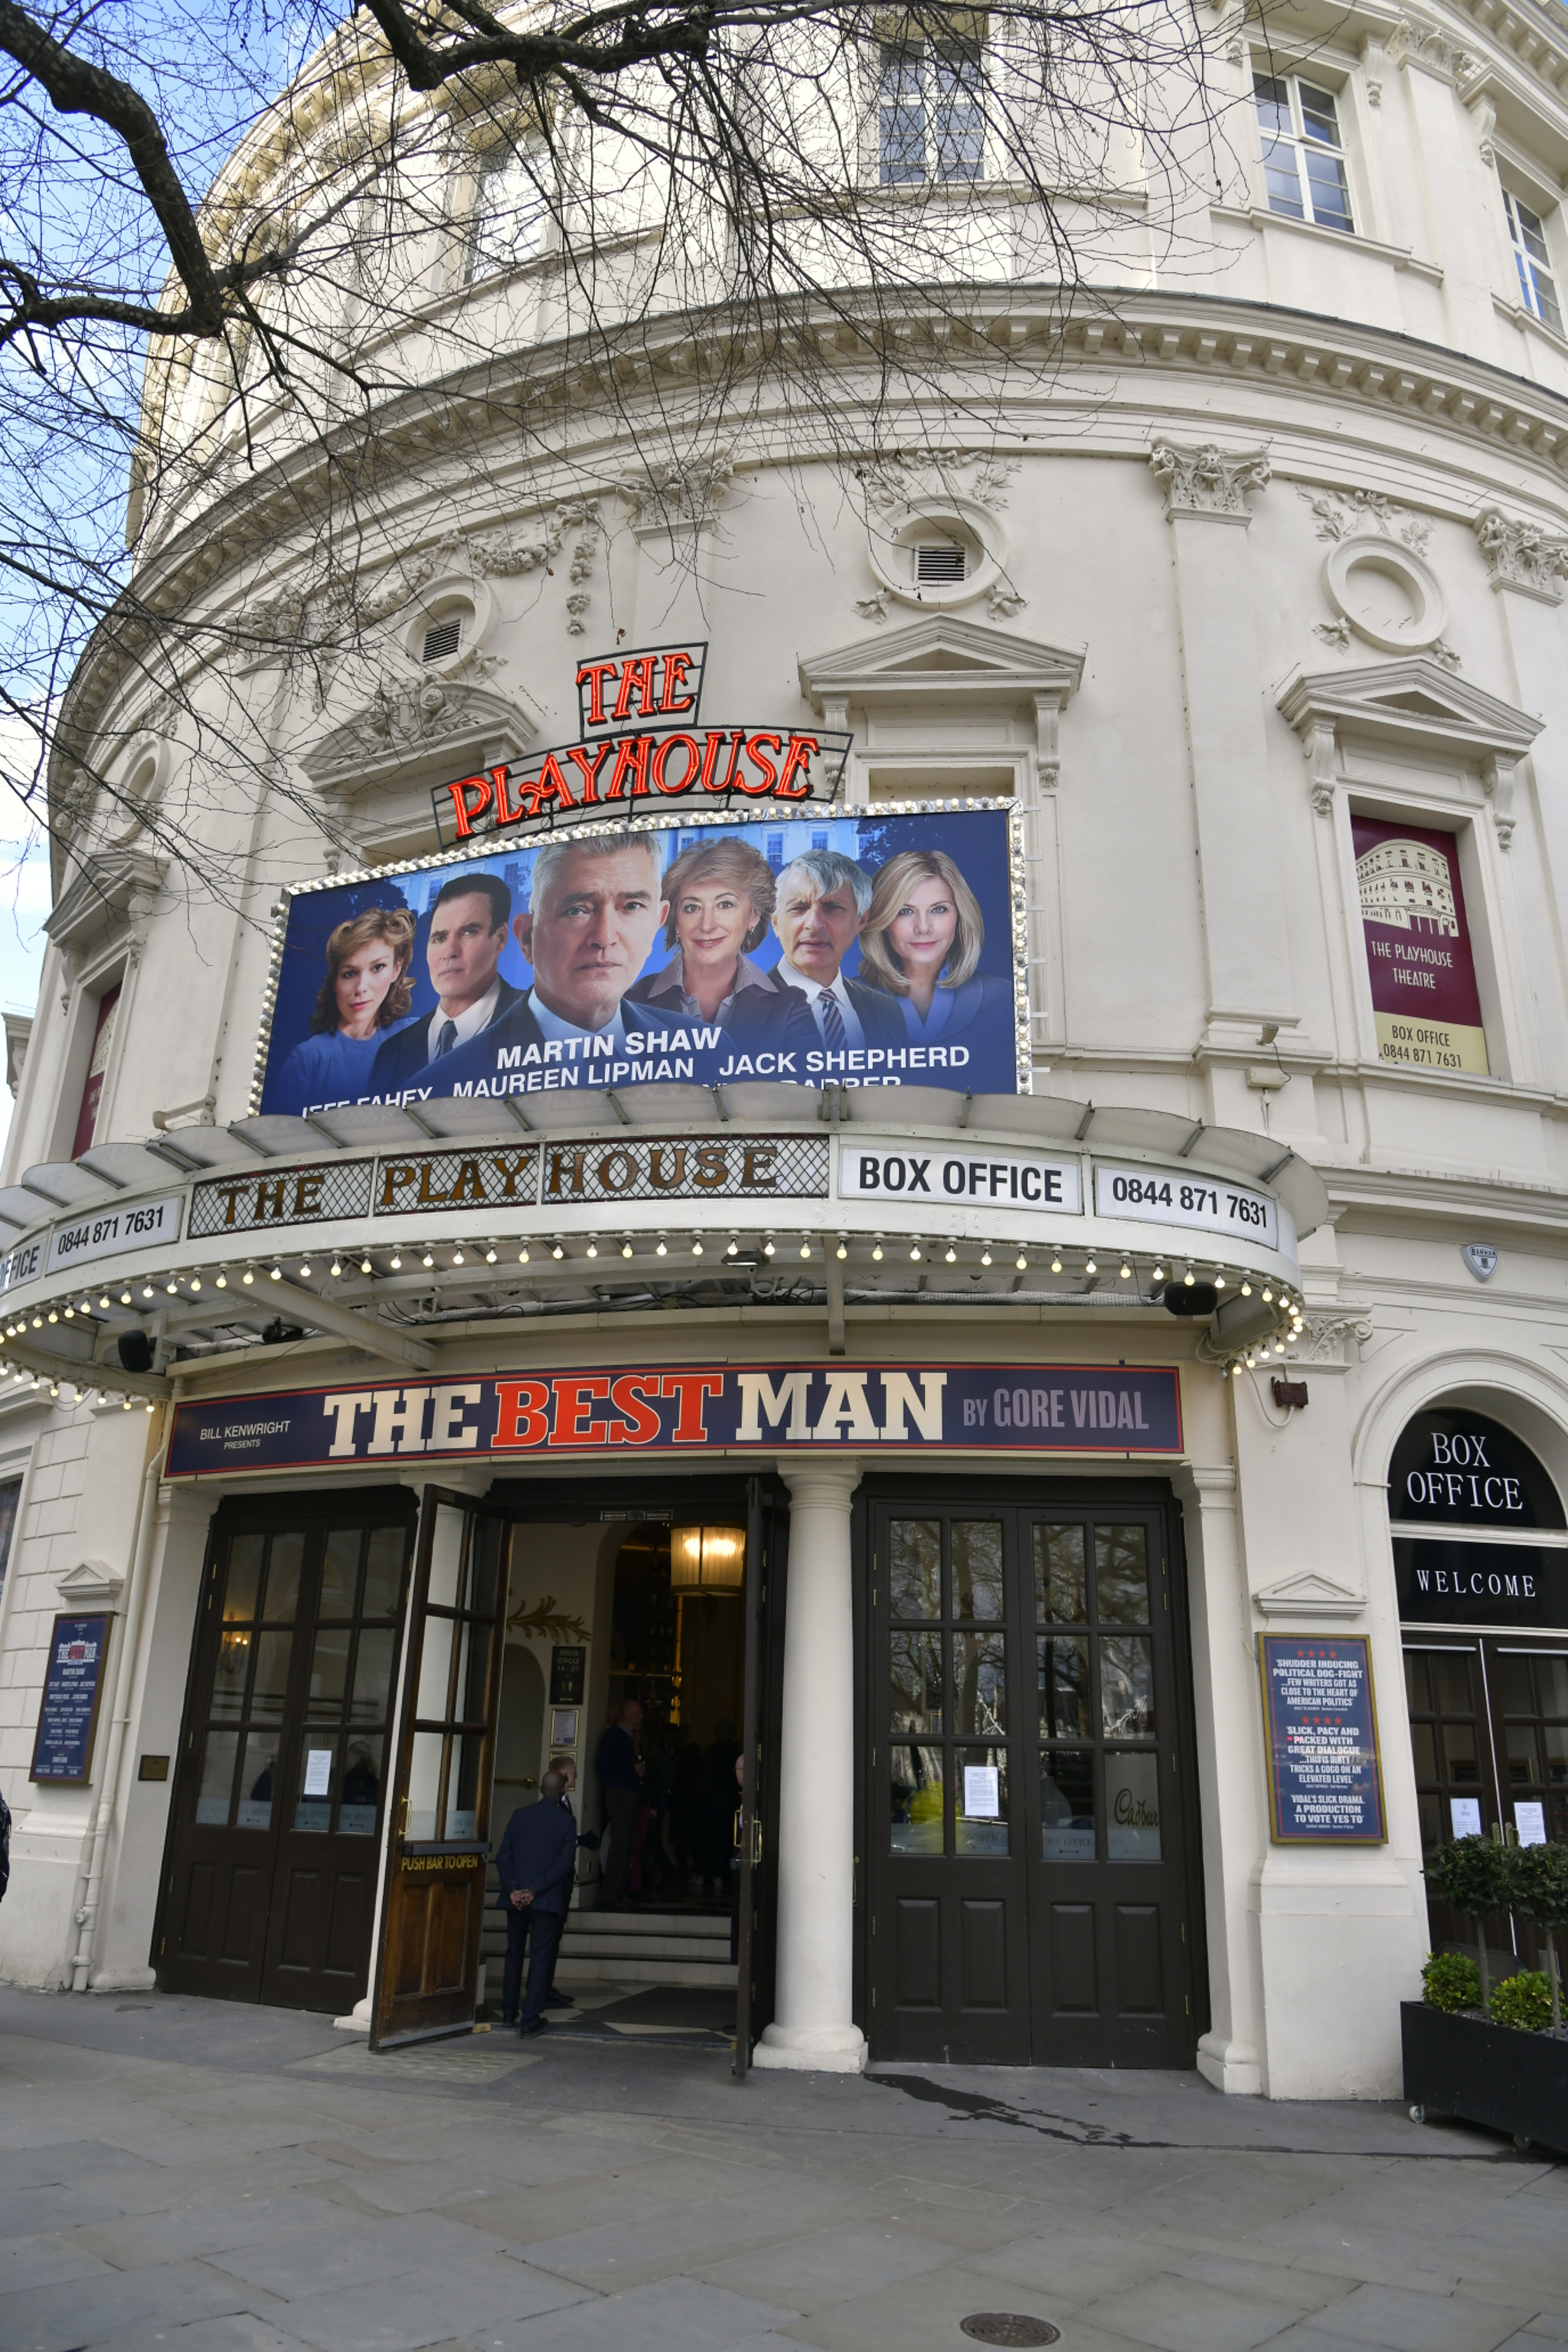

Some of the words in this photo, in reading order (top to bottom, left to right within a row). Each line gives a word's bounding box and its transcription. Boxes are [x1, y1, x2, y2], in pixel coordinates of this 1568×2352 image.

[576, 652, 697, 727] THE
[448, 732, 822, 839] PLAYHOUSE
[1371, 940, 1392, 958] THE
[1395, 943, 1453, 968] PLAYHOUSE
[1393, 968, 1436, 989] THEATRE
[1392, 1024, 1413, 1042] BOX
[1416, 1027, 1450, 1047] OFFICE
[497, 1031, 615, 1070] MARTIN
[625, 1027, 722, 1056] SHAW
[1383, 1043, 1410, 1060] 0844
[1413, 1047, 1432, 1064] 871
[1436, 1050, 1462, 1068] 7631
[452, 1065, 579, 1099] MAUREEN
[587, 1057, 694, 1084] LIPMAN
[719, 1051, 797, 1076] JACK
[805, 1046, 970, 1072] SHEPHERD
[859, 1157, 931, 1192] BOX
[942, 1161, 1063, 1203] OFFICE
[218, 1176, 325, 1224] THE
[1112, 1176, 1173, 1207] 0844
[1179, 1186, 1219, 1215] 871
[1227, 1195, 1268, 1228] 7631
[57, 1228, 90, 1256] 0844
[93, 1217, 118, 1246] 871
[124, 1205, 165, 1234] 7631
[1471, 1248, 1496, 1256] BANHAM
[323, 1383, 482, 1457] THE
[490, 1374, 724, 1448] BEST
[735, 1372, 947, 1441] MAN
[962, 1398, 988, 1427] BY
[994, 1388, 1064, 1429] GORE
[1070, 1390, 1149, 1429] VIDAL
[200, 1425, 222, 1441] BILL
[224, 1420, 291, 1439] KENWRIGHT
[224, 1439, 261, 1450] PRESENTS
[1431, 1432, 1491, 1468] BOX
[1406, 1471, 1523, 1510] OFFICE
[1416, 1570, 1536, 1597] WELCOME
[1273, 1668, 1315, 1677] POLITICAL
[1317, 1670, 1363, 1679] DOG-FIGHT
[1318, 1660, 1358, 1669] INDUCING
[1303, 1678, 1332, 1687] WRITERS
[1334, 1679, 1347, 1687] GOT
[1348, 1679, 1357, 1687] AS
[1281, 1687, 1301, 1696] CLOSE
[1303, 1687, 1311, 1696] TO
[1313, 1688, 1325, 1697] THE
[1327, 1688, 1348, 1697] HEART
[1350, 1689, 1357, 1697] OF
[1287, 1697, 1321, 1706] AMERICAN
[1317, 1726, 1339, 1736] PACY
[1341, 1727, 1359, 1736] AND
[1294, 1736, 1328, 1745] PACKED
[1329, 1736, 1353, 1745] WITH
[1288, 1745, 1315, 1754] GREAT
[1317, 1746, 1361, 1755] DIALOGUE
[1322, 1756, 1328, 1764] IS
[1330, 1756, 1350, 1764] DIRTY
[1289, 1765, 1314, 1773] TRICKS
[1315, 1765, 1320, 1773] A
[1341, 1766, 1351, 1774] ON
[1352, 1766, 1361, 1774] AN
[1299, 1775, 1331, 1783] ELEVATED
[1115, 1788, 1159, 1827] Cadbur
[1318, 1795, 1338, 1804] SLICK
[1339, 1795, 1365, 1805] DRAMA.
[1296, 1805, 1302, 1813] A
[1304, 1805, 1361, 1814] PRODUCTION
[1294, 1815, 1306, 1823] TO
[1308, 1815, 1331, 1824] VOTE
[1332, 1815, 1349, 1824] YES
[1063, 1838, 1093, 1847] OFFICE
[402, 1856, 426, 1871] PUSH
[426, 1856, 443, 1870] BAR
[445, 1855, 456, 1869] TO
[456, 1855, 479, 1869] OPEN
